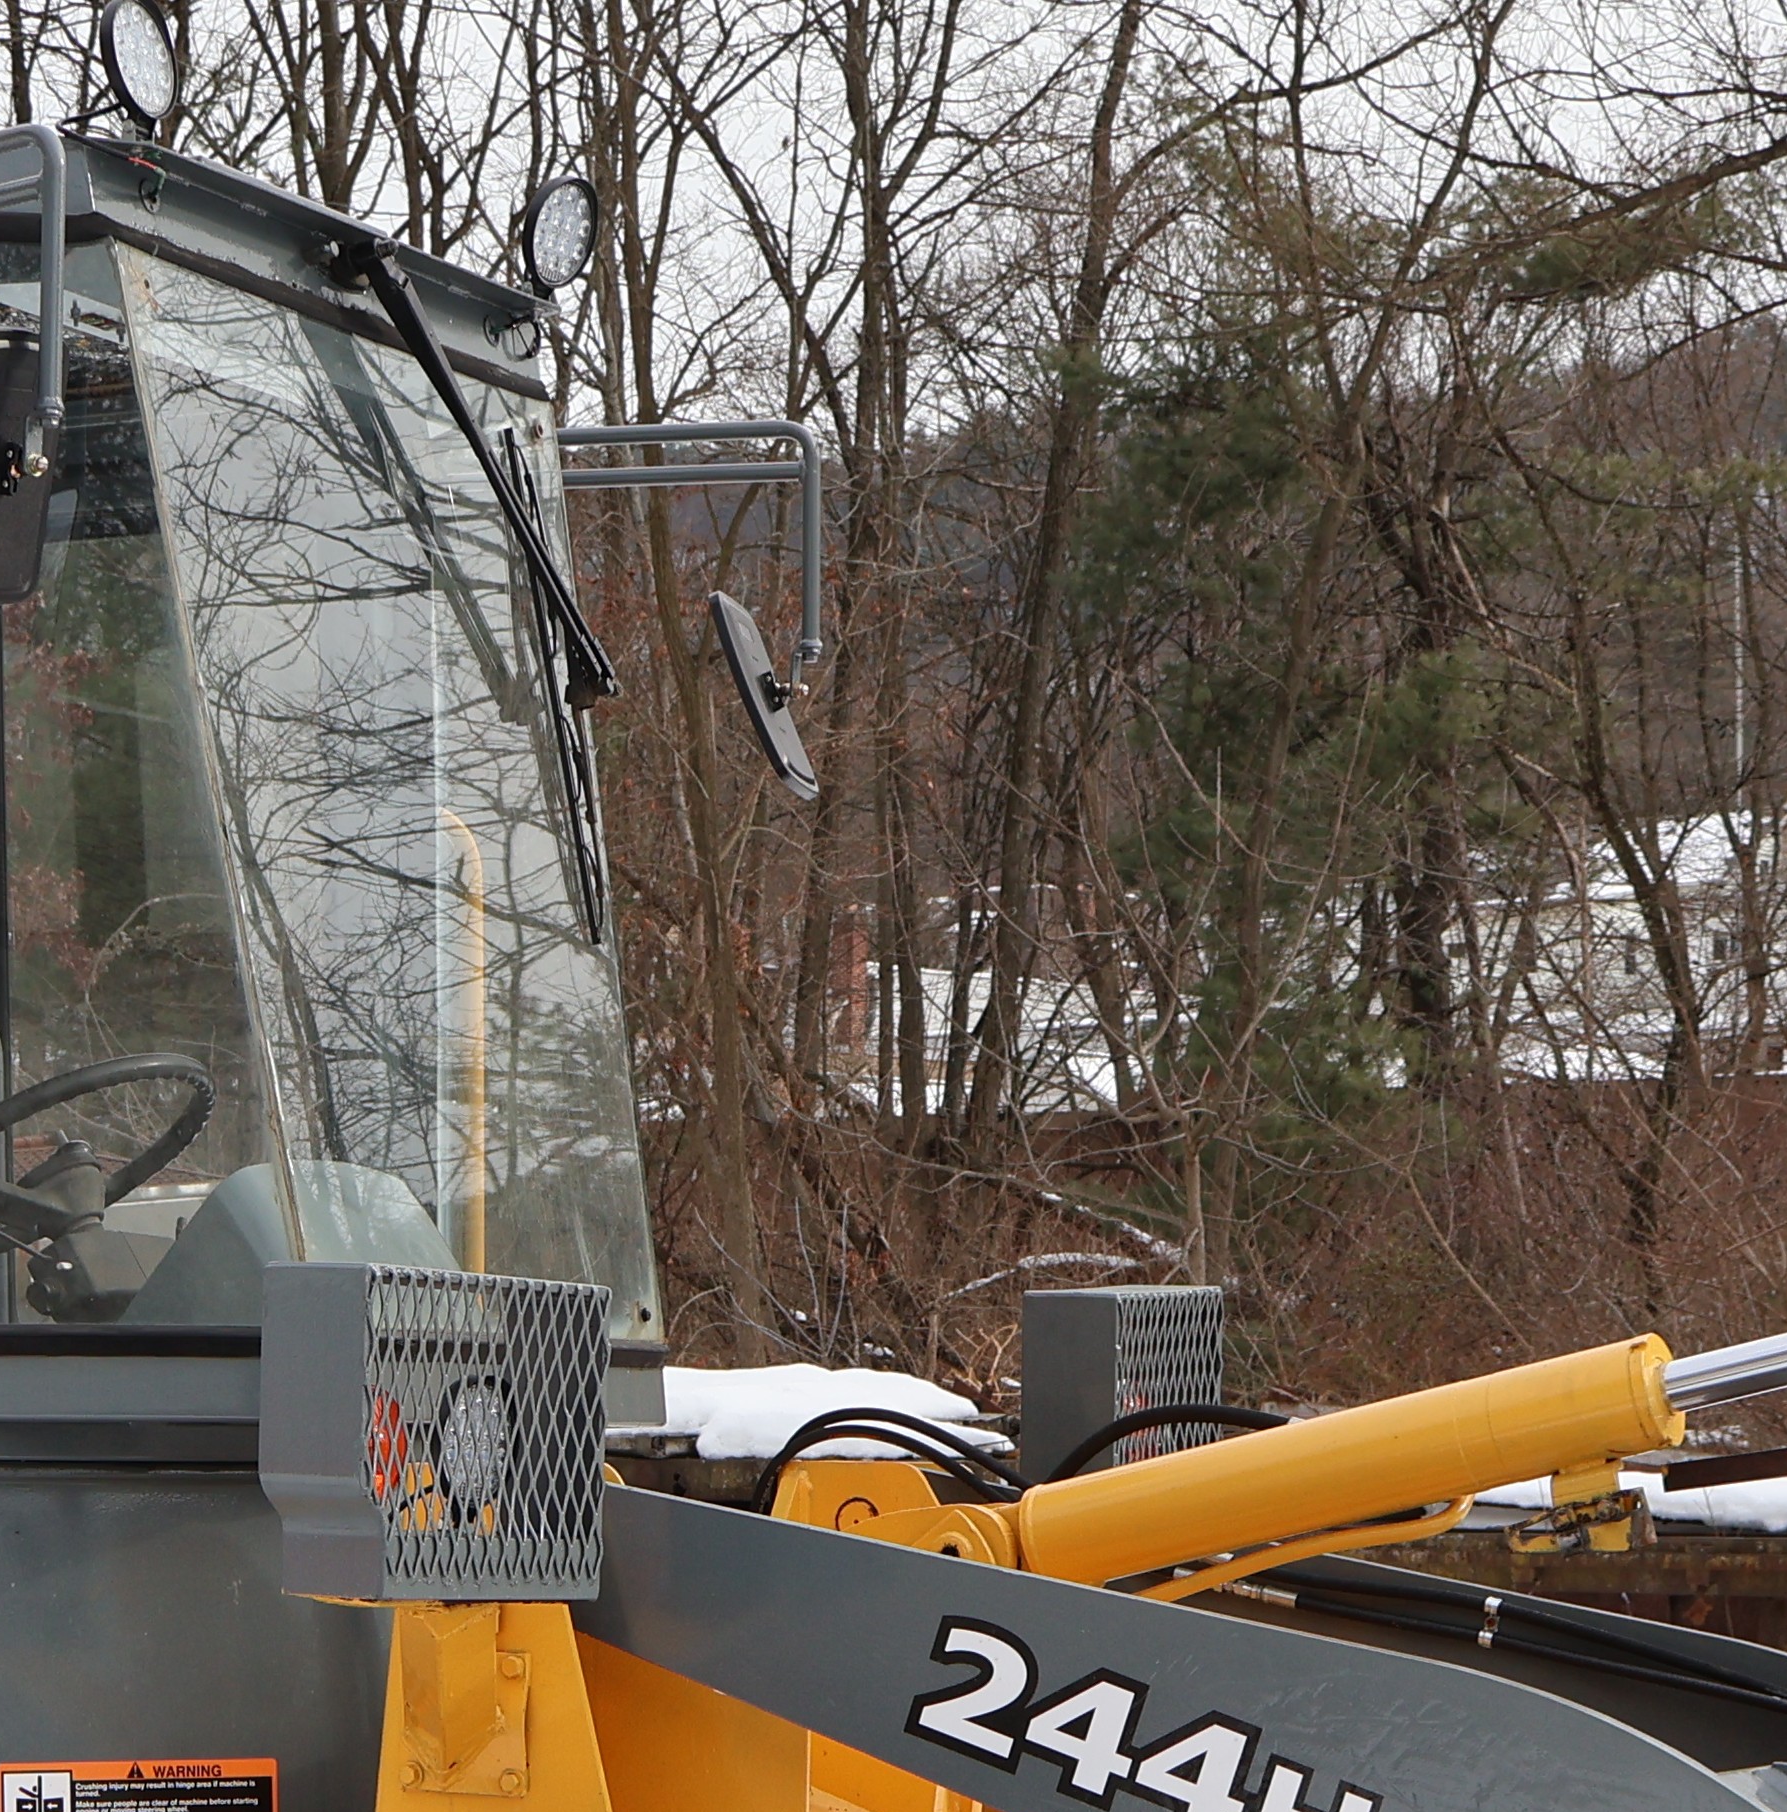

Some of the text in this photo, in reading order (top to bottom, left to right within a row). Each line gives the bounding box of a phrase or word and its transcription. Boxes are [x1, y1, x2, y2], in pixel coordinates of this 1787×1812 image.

[152, 1765, 222, 1778] WARNING
[75, 1783, 107, 1792] Crushing
[109, 1782, 128, 1791] injury
[176, 1781, 195, 1790] hinge
[219, 1780, 248, 1788] machine
[249, 1779, 256, 1787] is
[113, 1800, 137, 1809] people
[209, 1797, 232, 1805] before
[232, 1797, 259, 1806] starting
